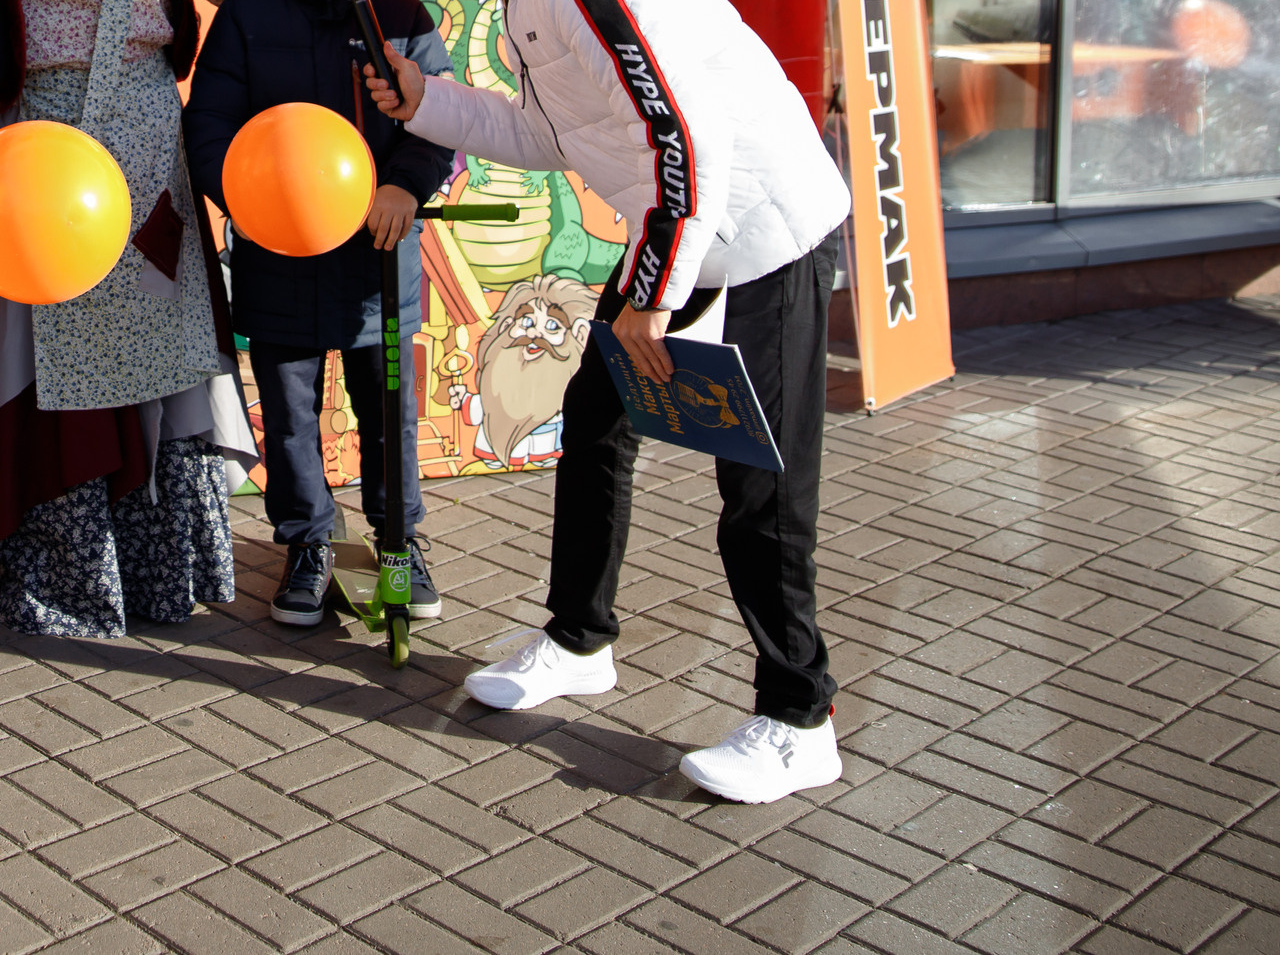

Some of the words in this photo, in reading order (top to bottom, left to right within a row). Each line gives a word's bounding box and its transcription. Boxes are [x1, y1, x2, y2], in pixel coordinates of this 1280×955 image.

[614, 42, 671, 116] HYPE
[634, 244, 661, 308] HYP
[655, 382, 685, 435] Марты
